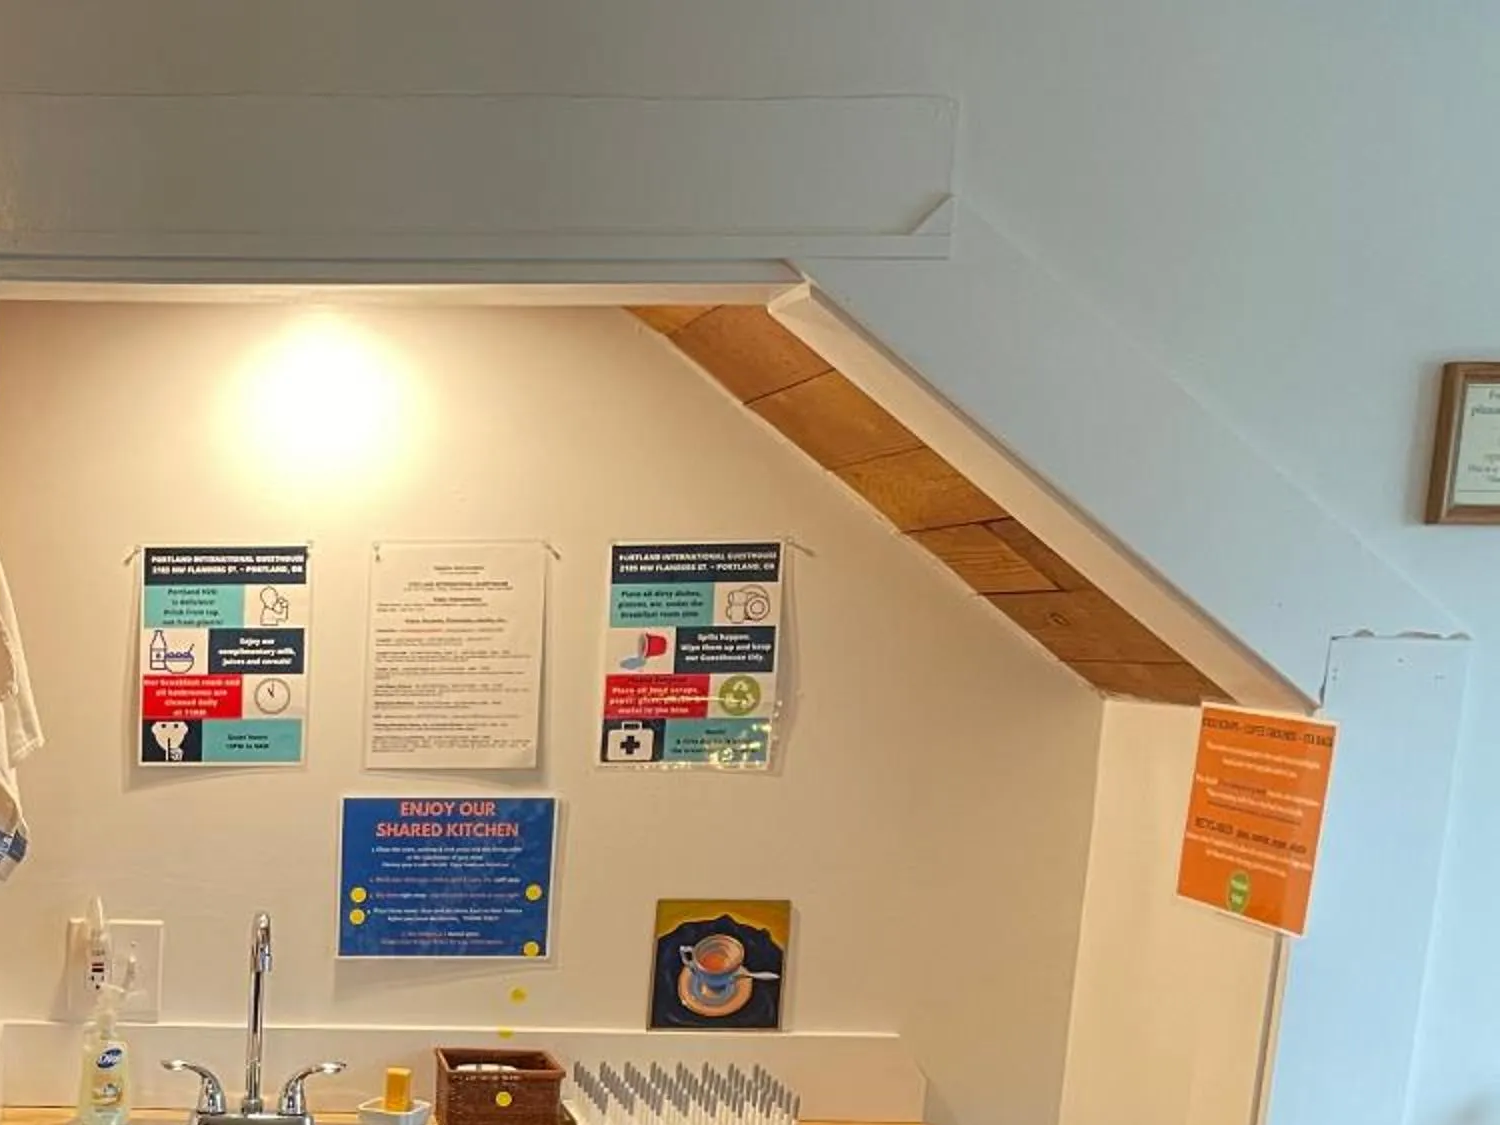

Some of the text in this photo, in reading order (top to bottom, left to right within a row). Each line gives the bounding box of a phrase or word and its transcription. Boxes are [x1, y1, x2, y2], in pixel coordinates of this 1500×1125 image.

[151, 555, 192, 563] PORTLAND
[619, 553, 660, 561] PORTLAND
[662, 552, 725, 561] INTERNATIONAL
[245, 565, 291, 574] PORTLAND,
[639, 564, 654, 572] NW
[400, 801, 496, 816] ENJOY OUR
[376, 822, 519, 837] SHARED KITCHEN
